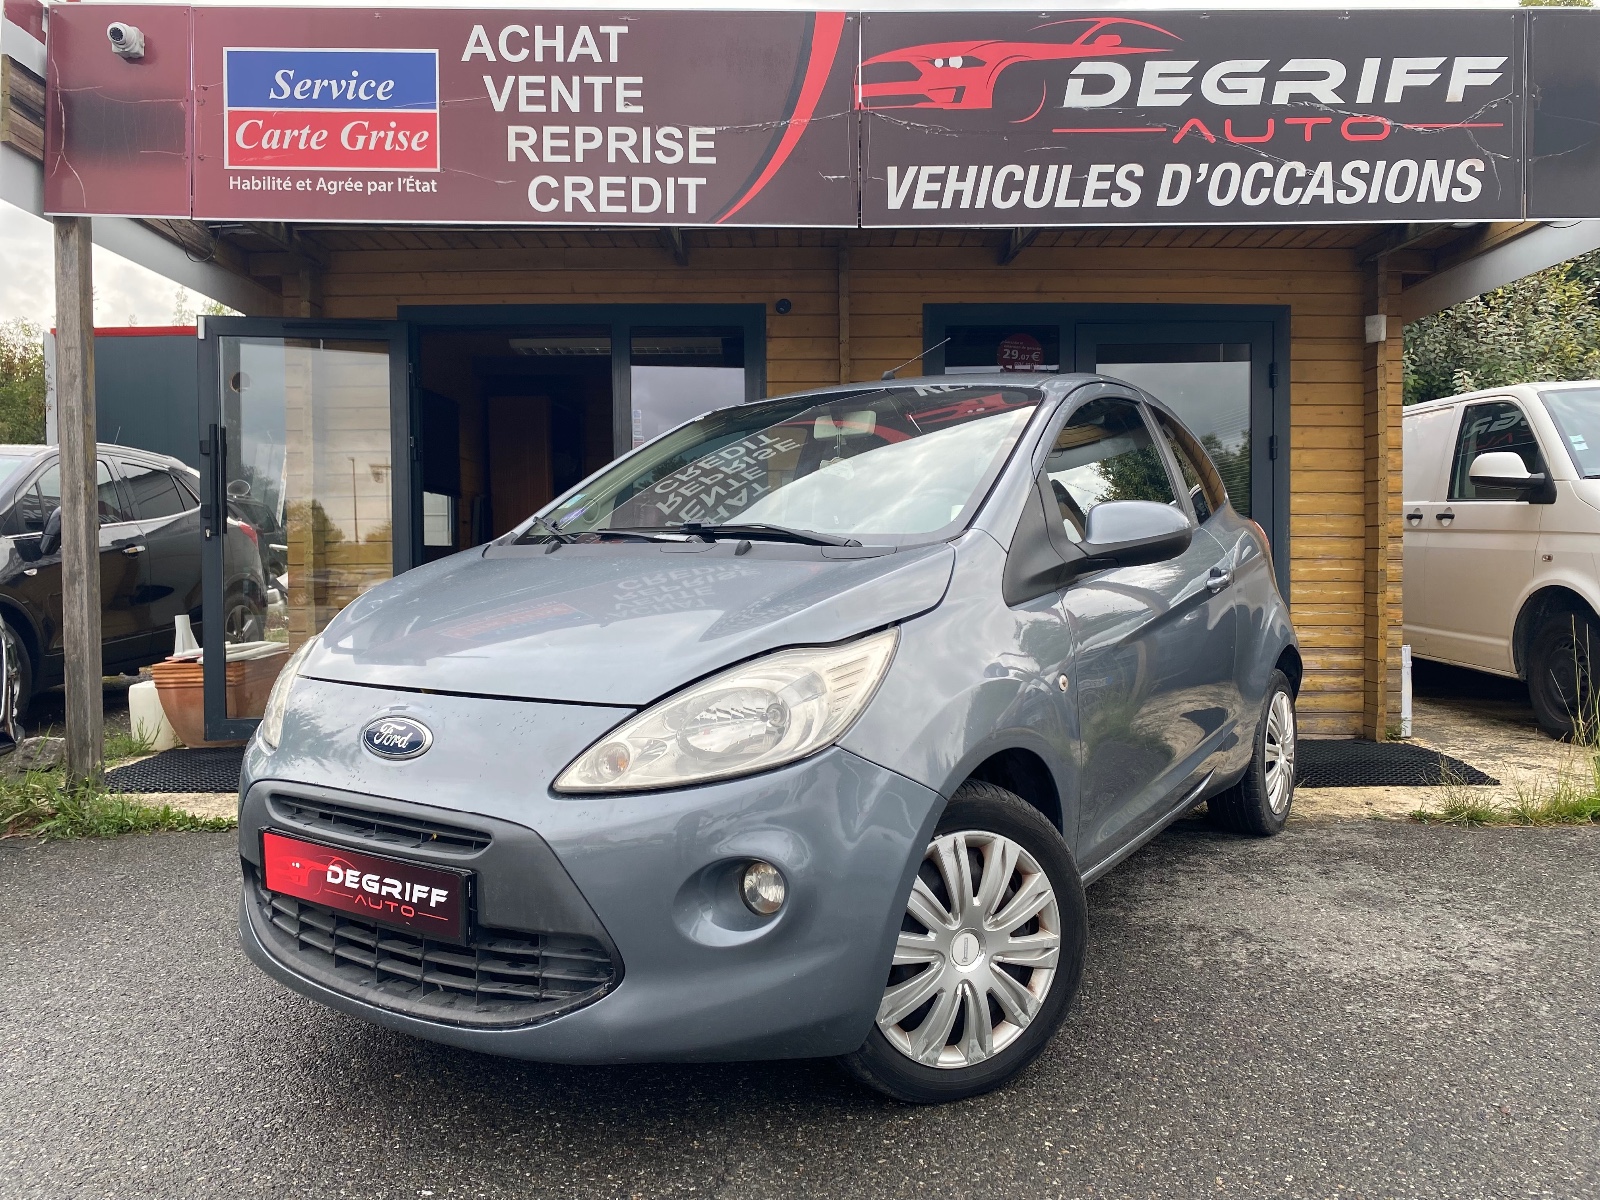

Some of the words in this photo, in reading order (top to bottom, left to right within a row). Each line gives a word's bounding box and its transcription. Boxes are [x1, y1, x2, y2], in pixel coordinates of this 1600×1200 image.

[461, 24, 629, 63] ACHAT
[268, 69, 395, 101] Service
[483, 75, 644, 114] VENTE
[1062, 56, 1508, 107] DEGRIFF
[235, 119, 329, 151] Carte
[340, 120, 430, 152] Grise
[507, 125, 717, 165] REPRISE
[1173, 116, 1391, 144] AUTO
[229, 175, 292, 191] Habilité
[296, 178, 312, 191] et
[316, 176, 364, 195] Agrée
[367, 179, 394, 196] par
[397, 175, 438, 193] l'État
[527, 175, 707, 213] CREDIT
[886, 164, 1143, 210] VEHICULES
[1156, 158, 1485, 207] D'OCCASIONS
[373, 722, 413, 748] Ford
[326, 865, 449, 908] DEGRIFF
[354, 895, 415, 918] AUTO
